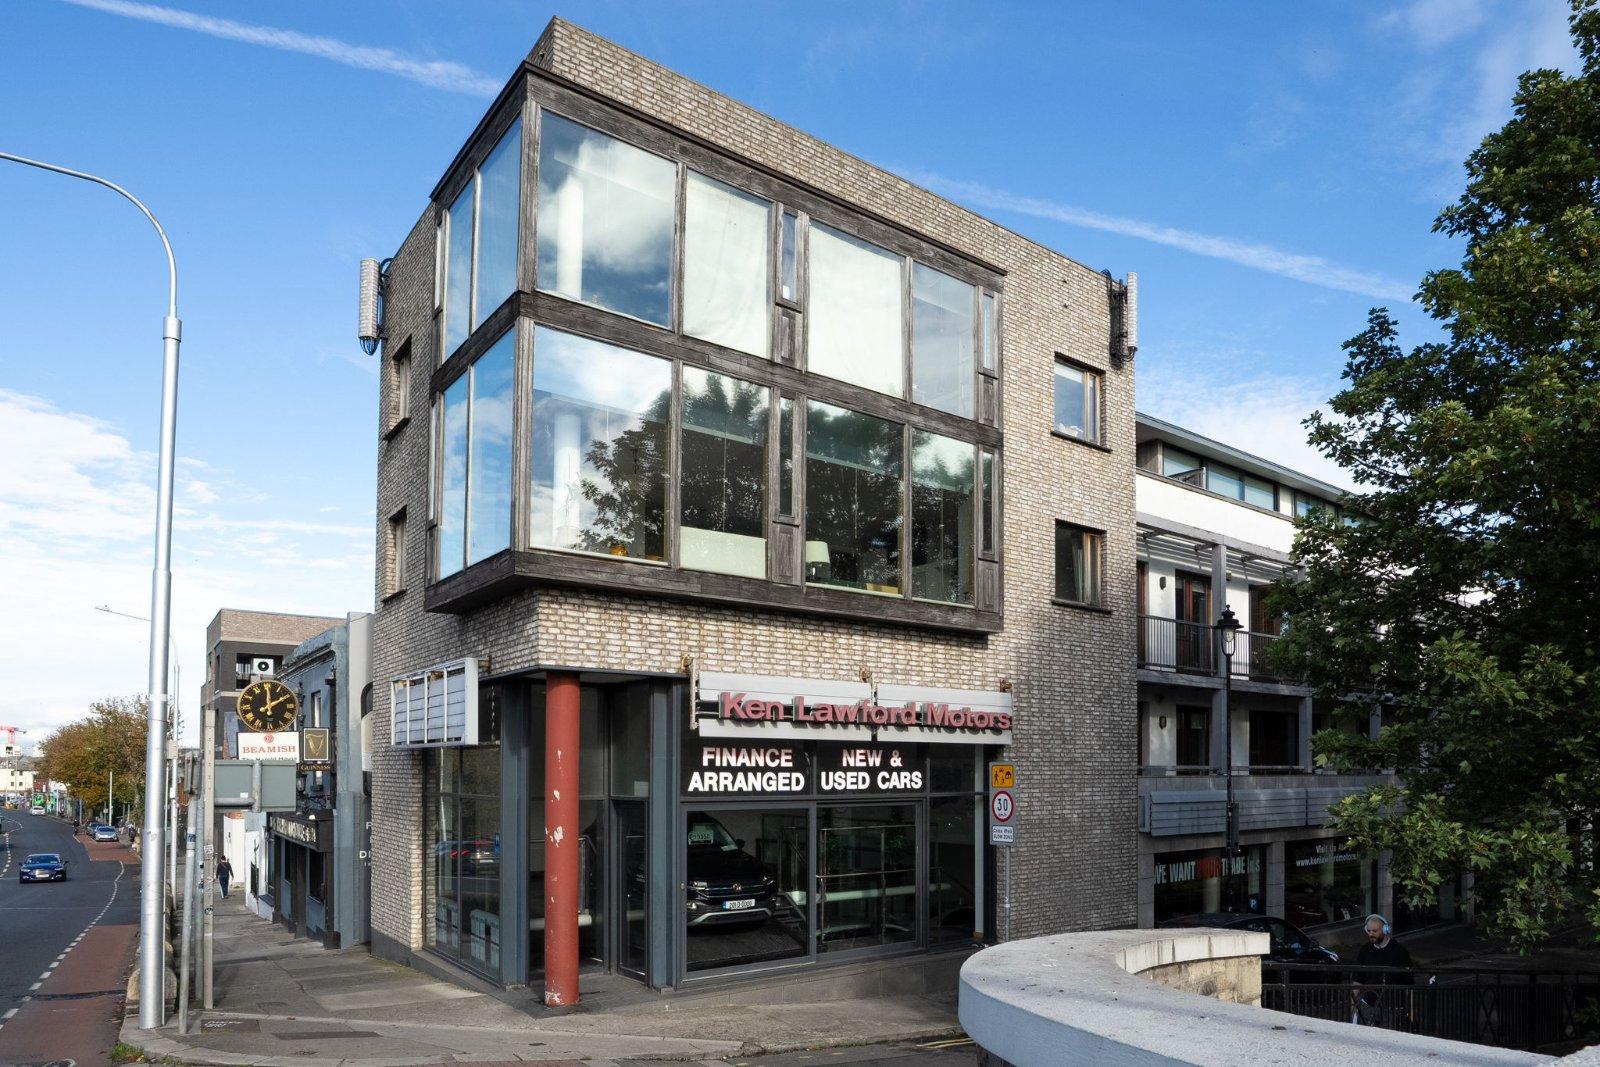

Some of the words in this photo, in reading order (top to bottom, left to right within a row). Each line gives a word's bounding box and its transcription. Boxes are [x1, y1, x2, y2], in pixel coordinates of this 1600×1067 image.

[720, 691, 785, 721] Ken
[793, 695, 917, 726] Lawford
[923, 703, 1013, 731] Motors
[242, 745, 296, 754] BEAMISH
[702, 748, 794, 768] FINANCE
[841, 749, 883, 767] NEW
[890, 750, 903, 766] &
[300, 764, 331, 772] GUINNESS
[688, 772, 806, 793] ARRANGED
[820, 771, 871, 791] USED
[877, 771, 923, 790] CARS
[997, 798, 1008, 811] 30
[1169, 860, 1196, 883] WANT
